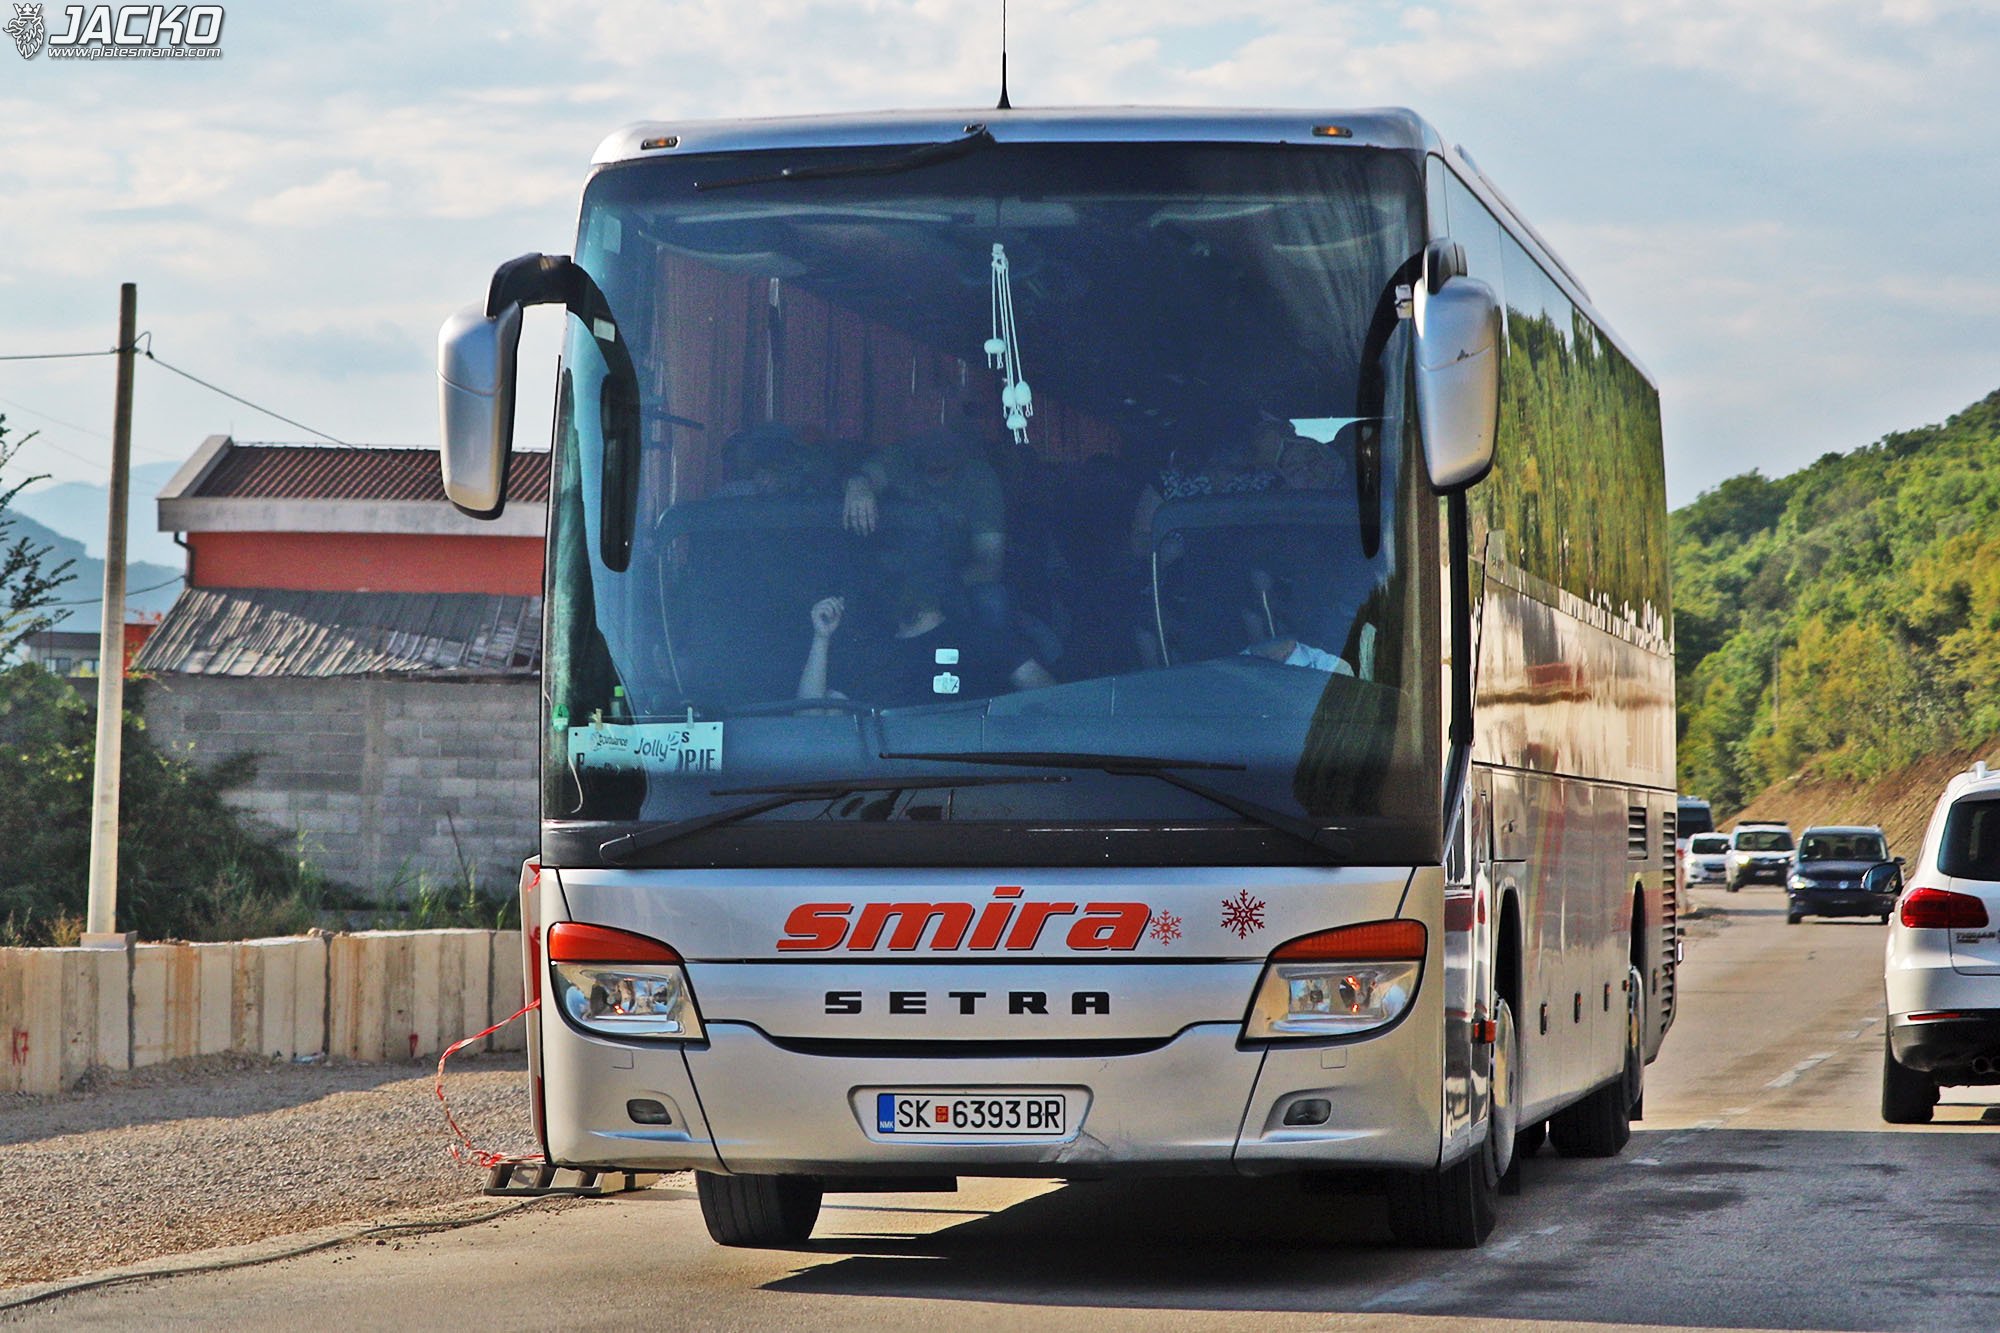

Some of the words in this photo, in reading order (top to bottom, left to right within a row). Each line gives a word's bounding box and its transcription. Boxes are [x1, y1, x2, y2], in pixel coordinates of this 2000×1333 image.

[634, 737, 669, 762] Jolly
[776, 886, 1152, 951] smira
[825, 991, 1111, 1015] SETRA
[898, 1100, 931, 1128] SK
